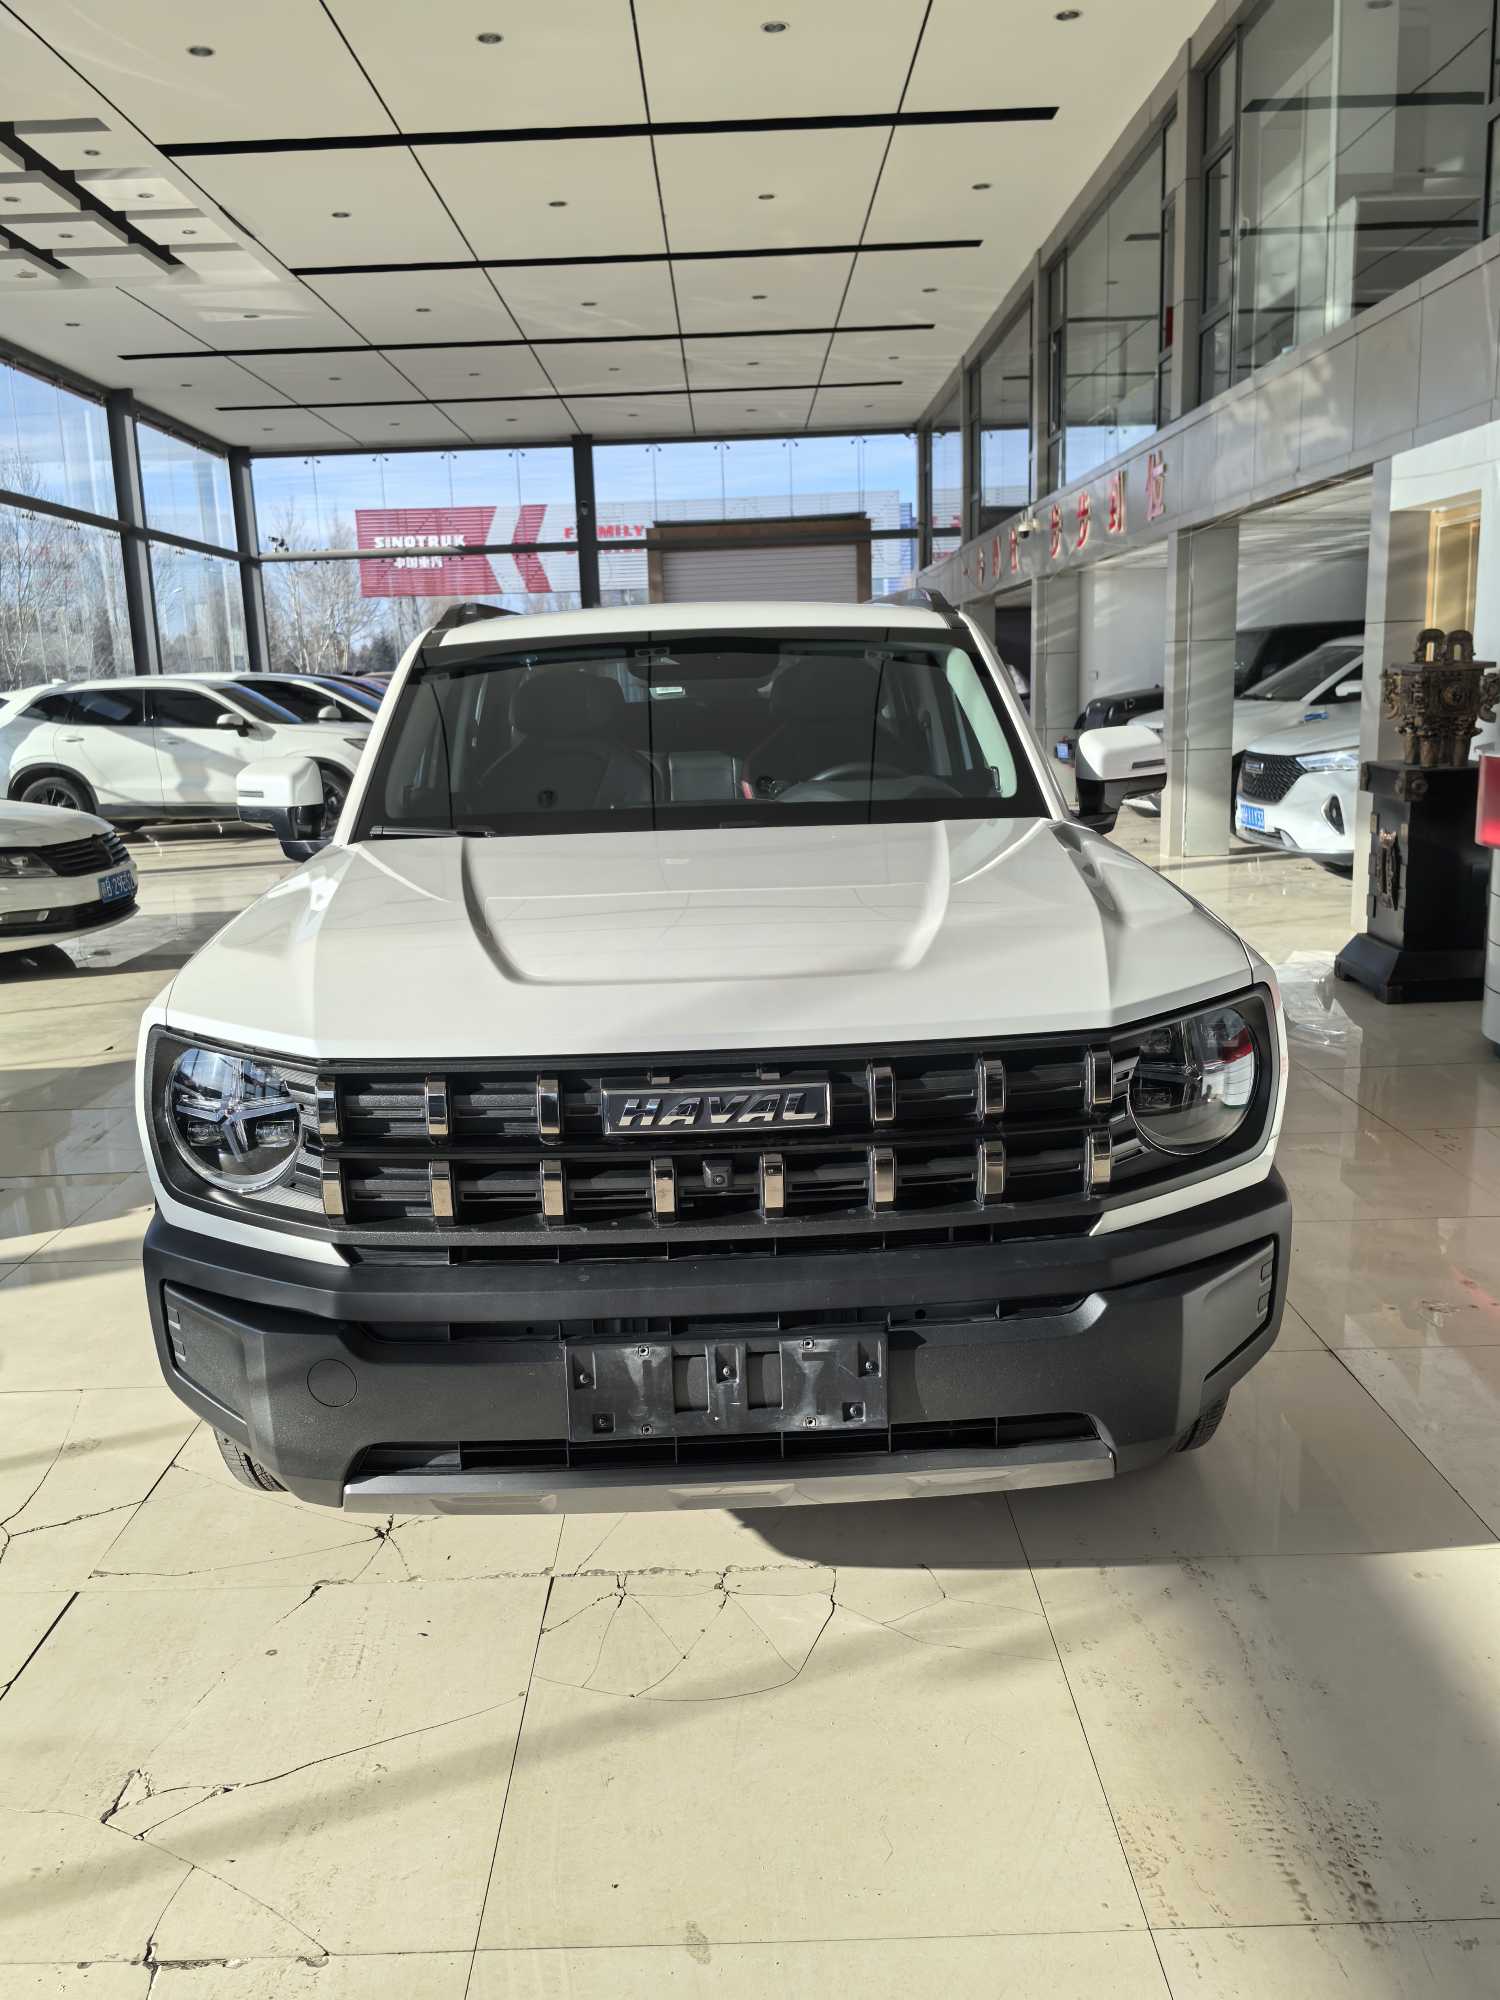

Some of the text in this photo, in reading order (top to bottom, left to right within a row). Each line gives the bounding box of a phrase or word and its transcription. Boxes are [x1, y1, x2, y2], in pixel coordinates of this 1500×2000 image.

[563, 525, 644, 539] FMILY
[374, 535, 465, 548] SINOTRUK
[618, 1092, 818, 1126] HAVAL
